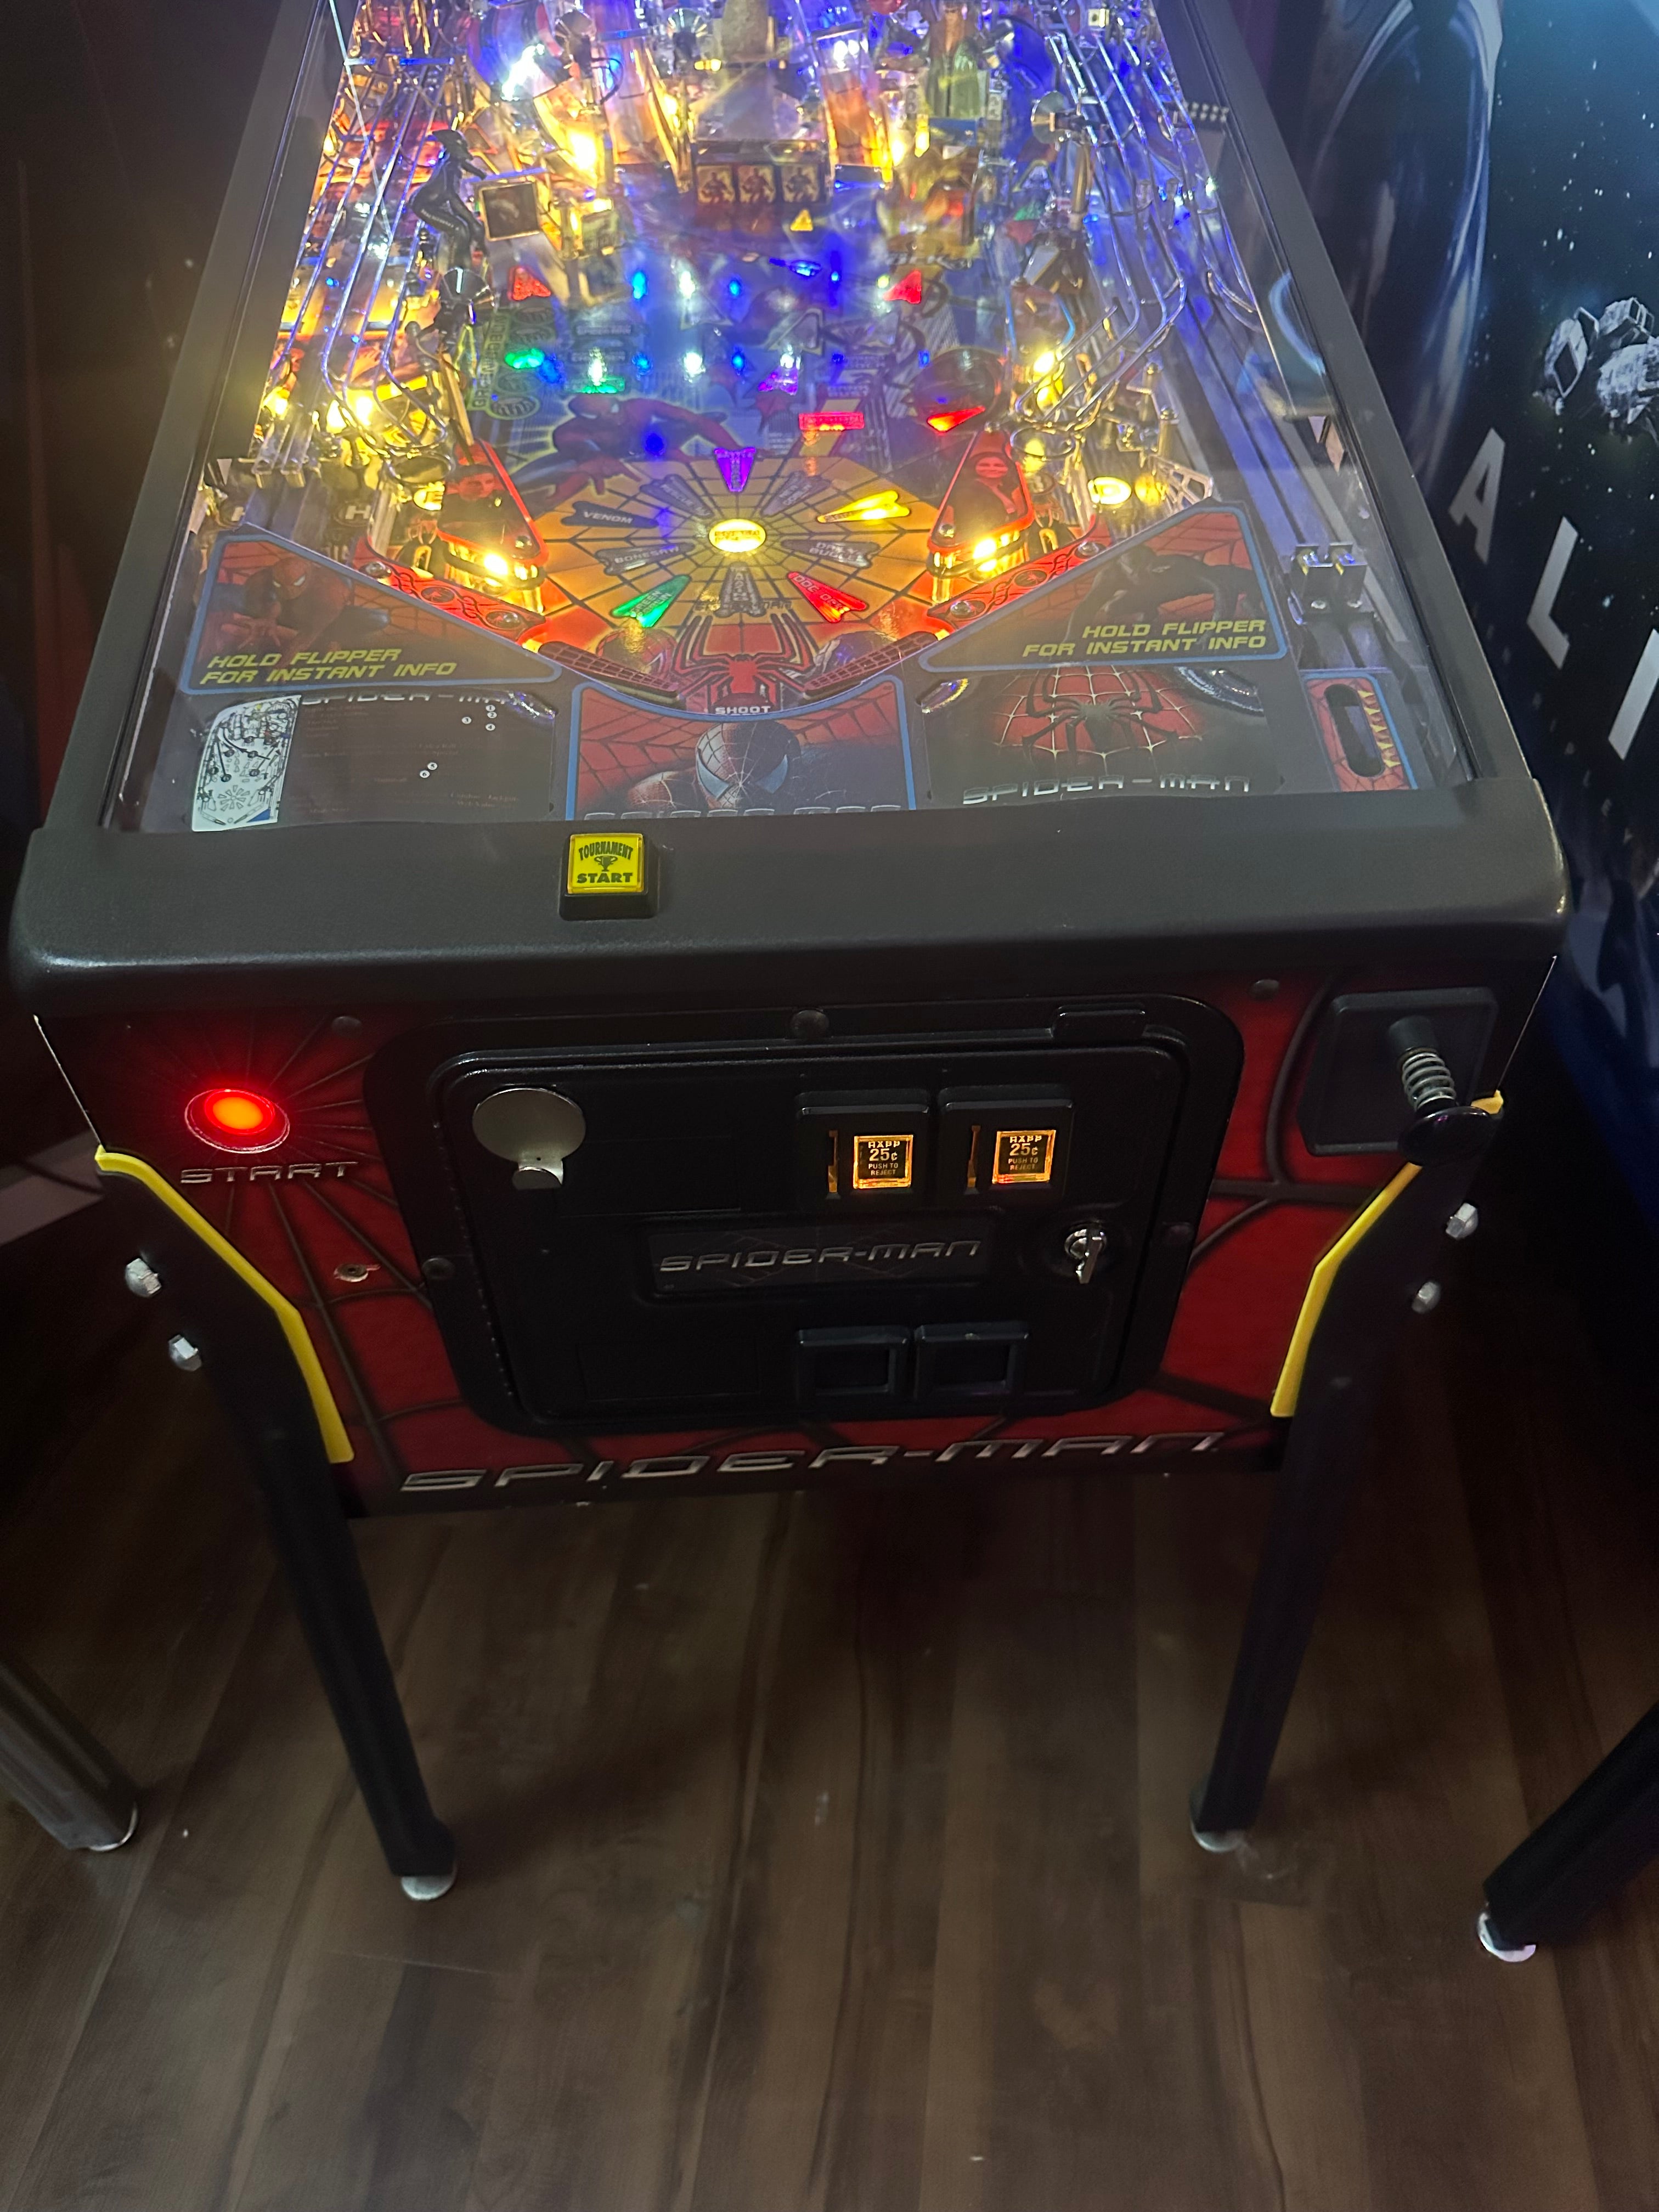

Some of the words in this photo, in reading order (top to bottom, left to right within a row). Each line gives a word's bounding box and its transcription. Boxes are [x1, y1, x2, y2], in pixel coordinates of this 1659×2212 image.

[583, 511, 633, 524] VENOM
[614, 545, 679, 564] BONESAW
[793, 574, 820, 593] DOC
[1082, 624, 1151, 639] HOLD
[1162, 619, 1267, 635] FLIPPER
[1022, 642, 1075, 658] FOR
[1086, 638, 1197, 655] INSTANT
[1208, 635, 1267, 650] INFO
[207, 653, 282, 669] HOLD
[290, 648, 402, 665] FLIPPER
[200, 670, 258, 685] FOR
[266, 664, 385, 682] INSTANT
[393, 662, 458, 677] INFO
[715, 706, 771, 714] SHOOT
[963, 774, 1251, 805] SPIDER-MAN
[578, 841, 634, 861] TOURNAMENT
[577, 872, 633, 884] START
[869, 1148, 898, 1162] 25¢
[1009, 1143, 1039, 1156] 25¢
[180, 1161, 359, 1184] START
[659, 1240, 981, 1272] SPIDER-MAN
[400, 1431, 1225, 1492] SPIDER-MAN
